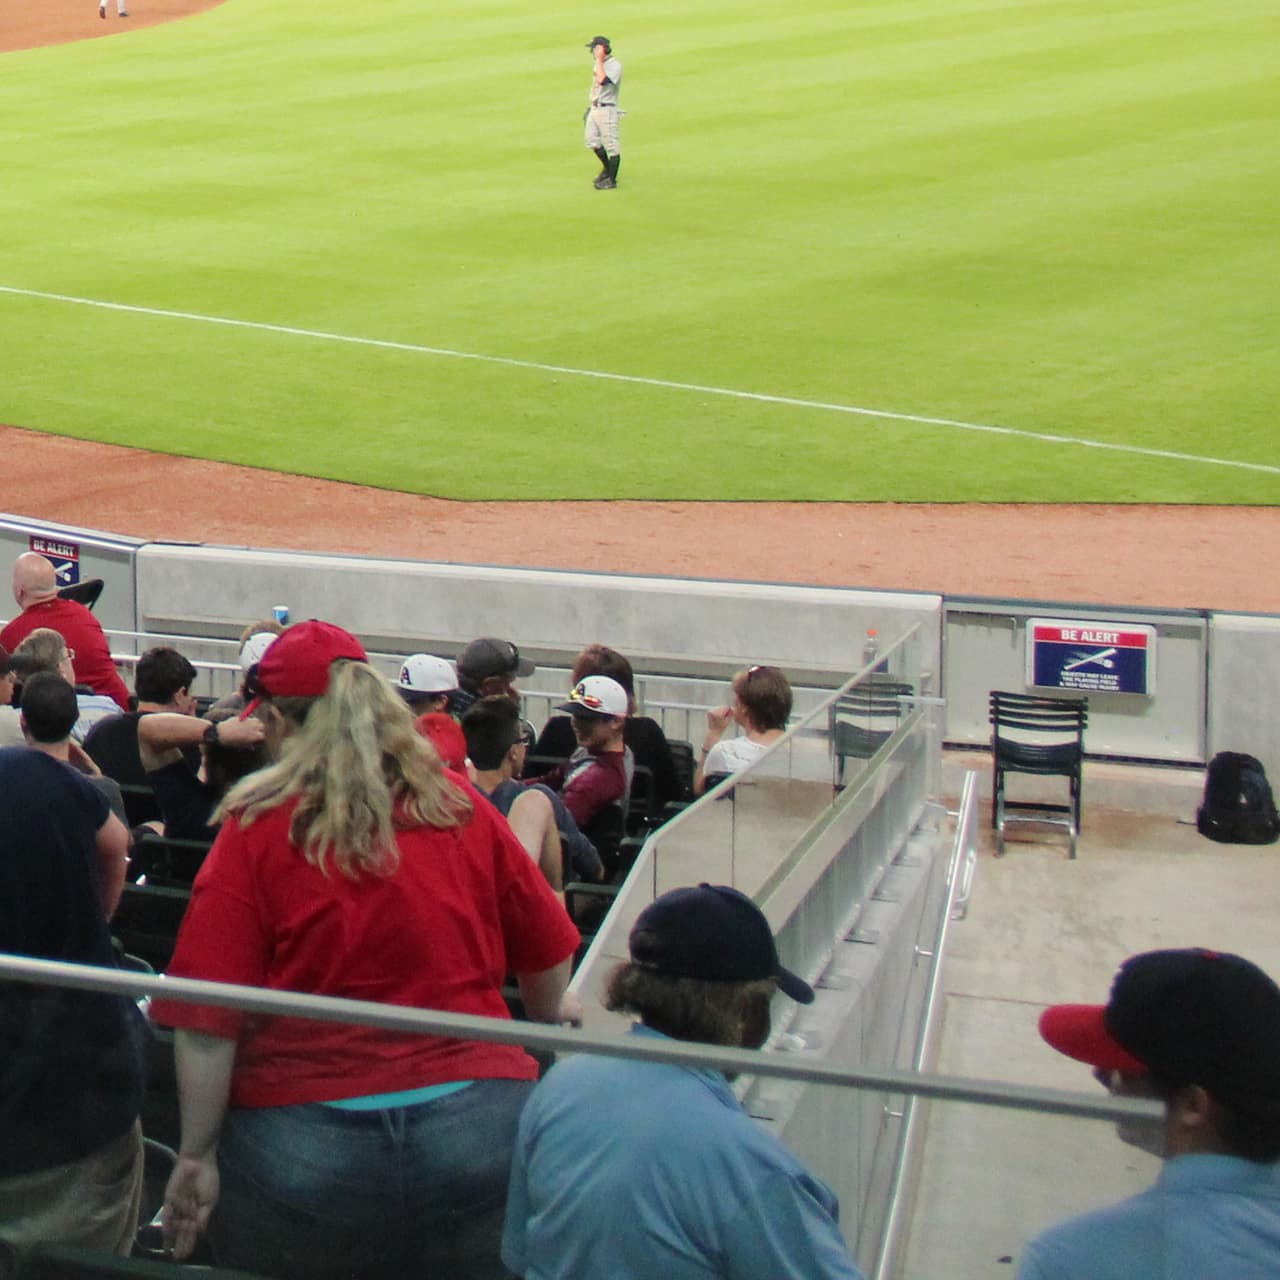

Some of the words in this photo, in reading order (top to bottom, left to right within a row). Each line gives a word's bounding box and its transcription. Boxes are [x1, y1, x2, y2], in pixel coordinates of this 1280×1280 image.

[33, 539, 46, 552] BE
[48, 542, 75, 558] ALERT
[1060, 629, 1079, 641] BE
[1080, 630, 1121, 644] ALERT
